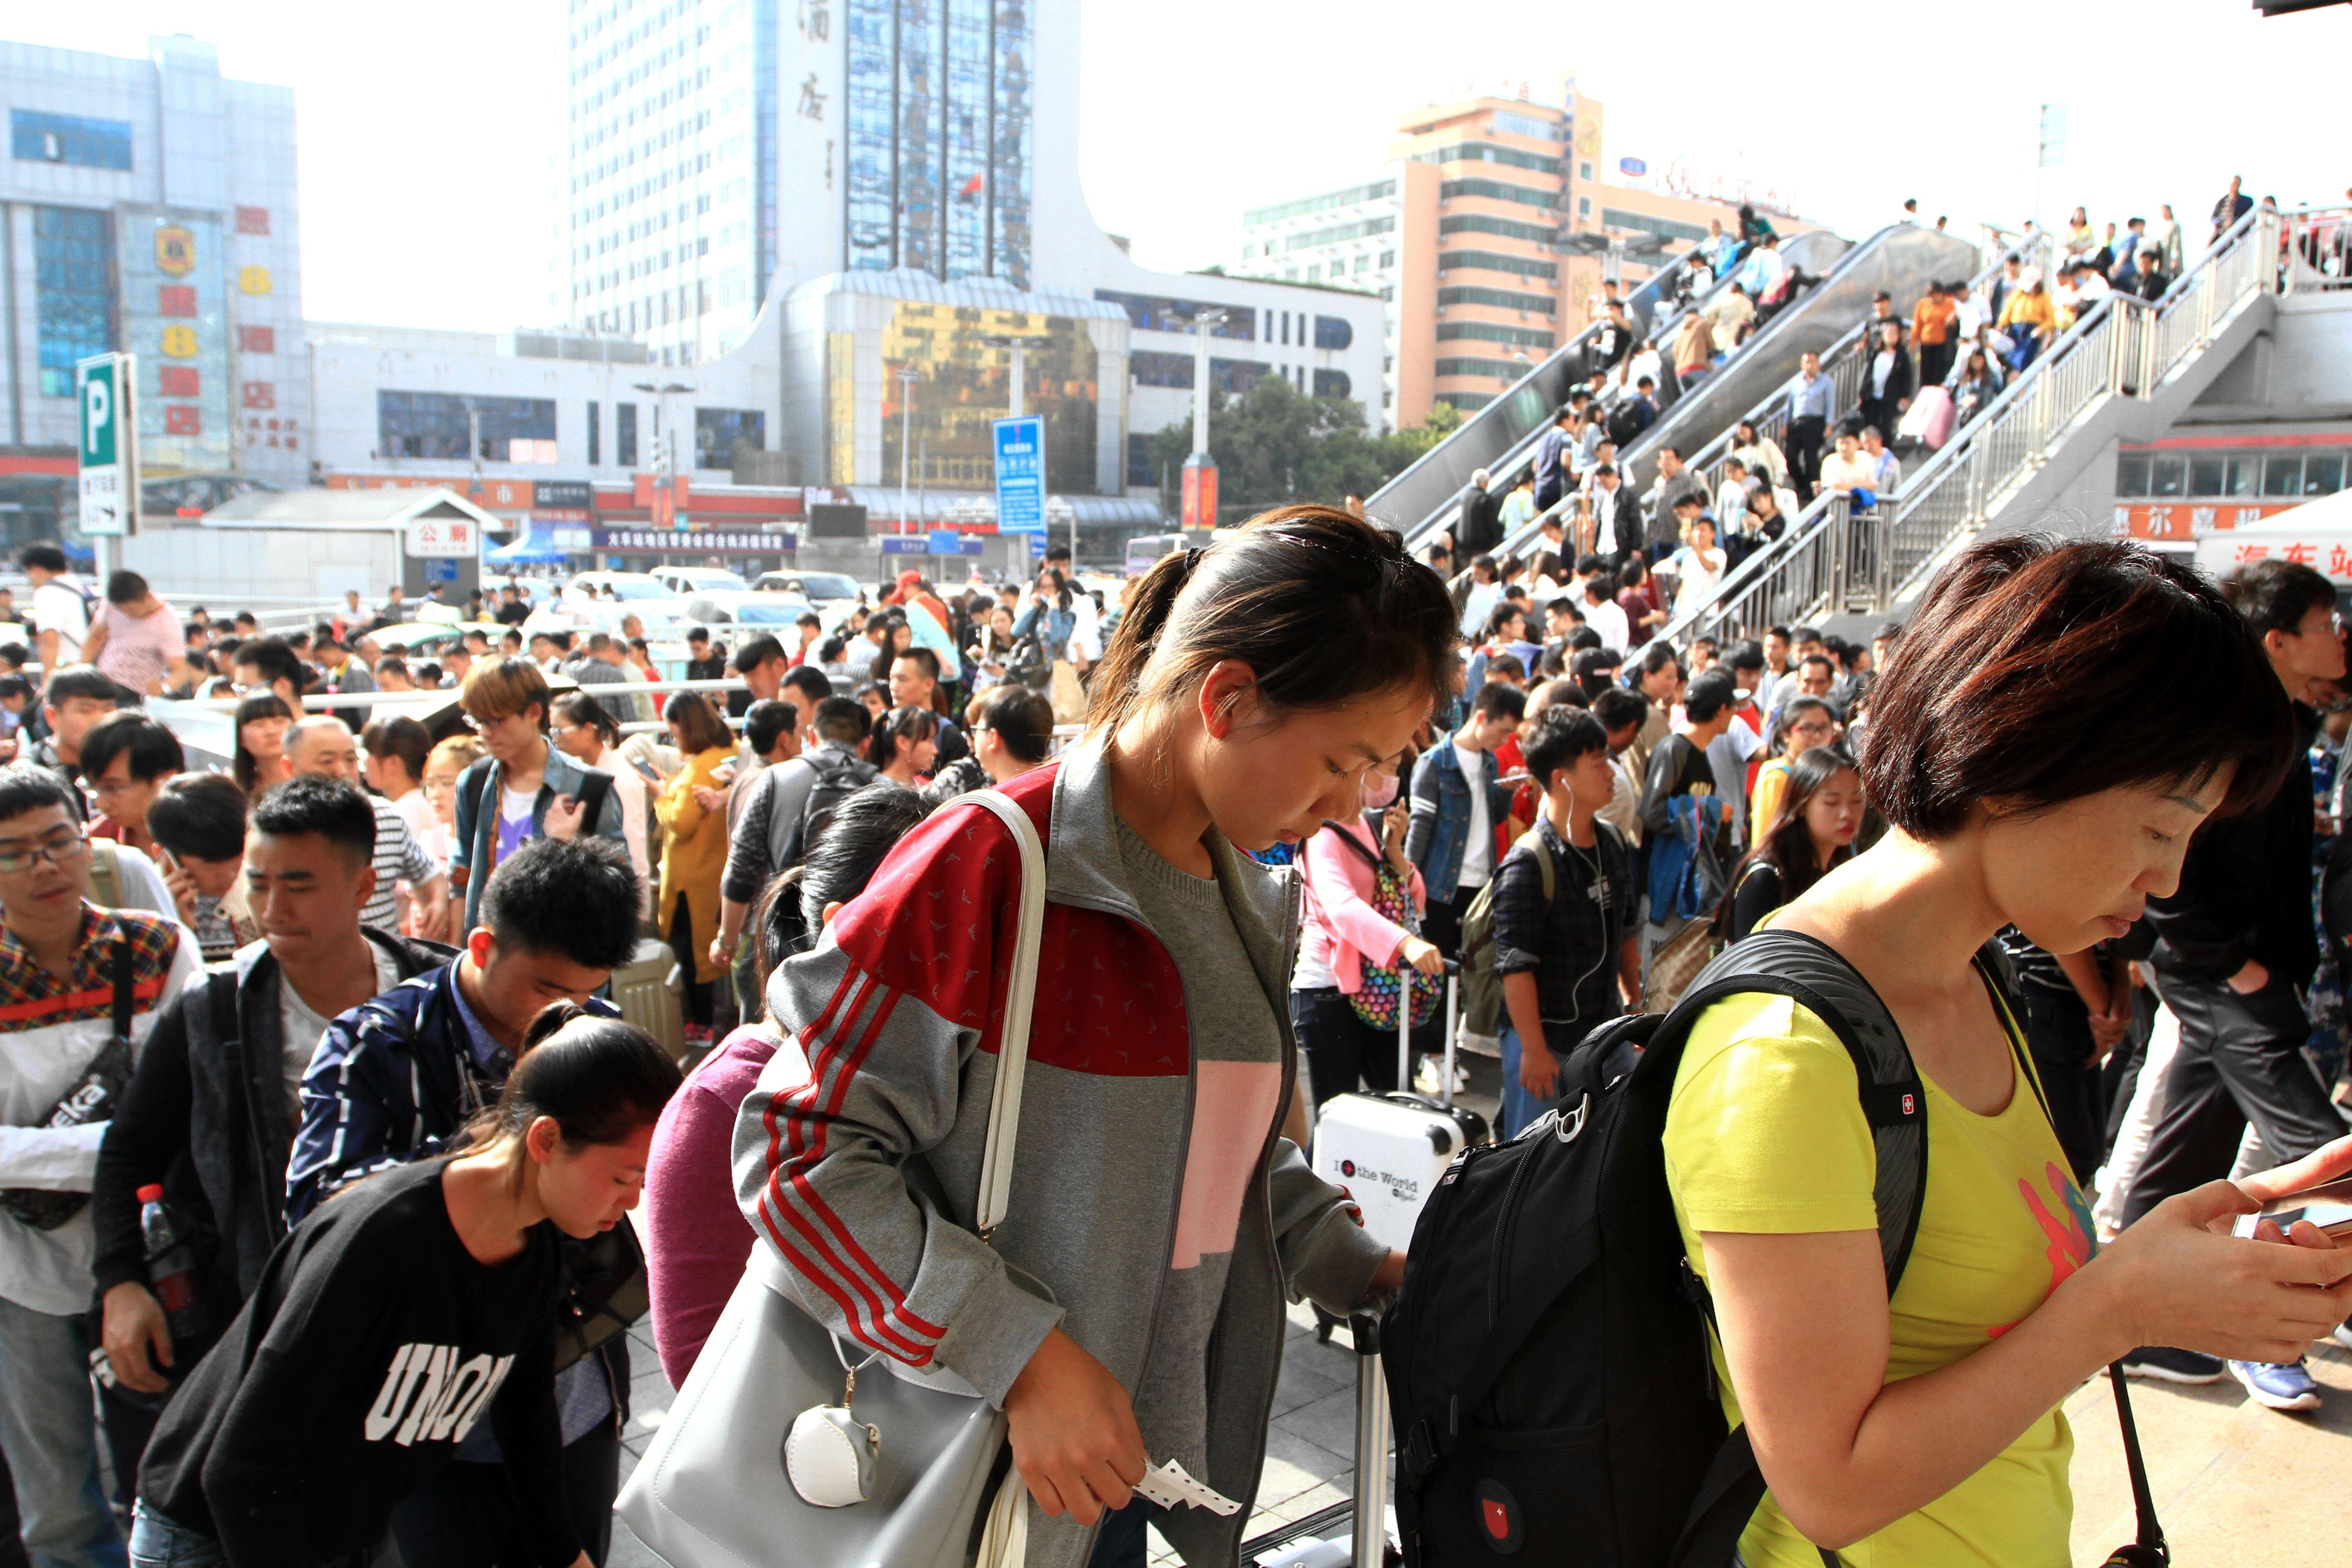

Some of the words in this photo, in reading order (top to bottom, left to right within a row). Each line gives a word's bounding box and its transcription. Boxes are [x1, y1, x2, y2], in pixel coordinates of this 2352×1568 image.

[158, 284, 200, 436] 8酒店
[88, 379, 109, 453] P
[1358, 1166, 1377, 1181] the
[1380, 1172, 1418, 1193] World
